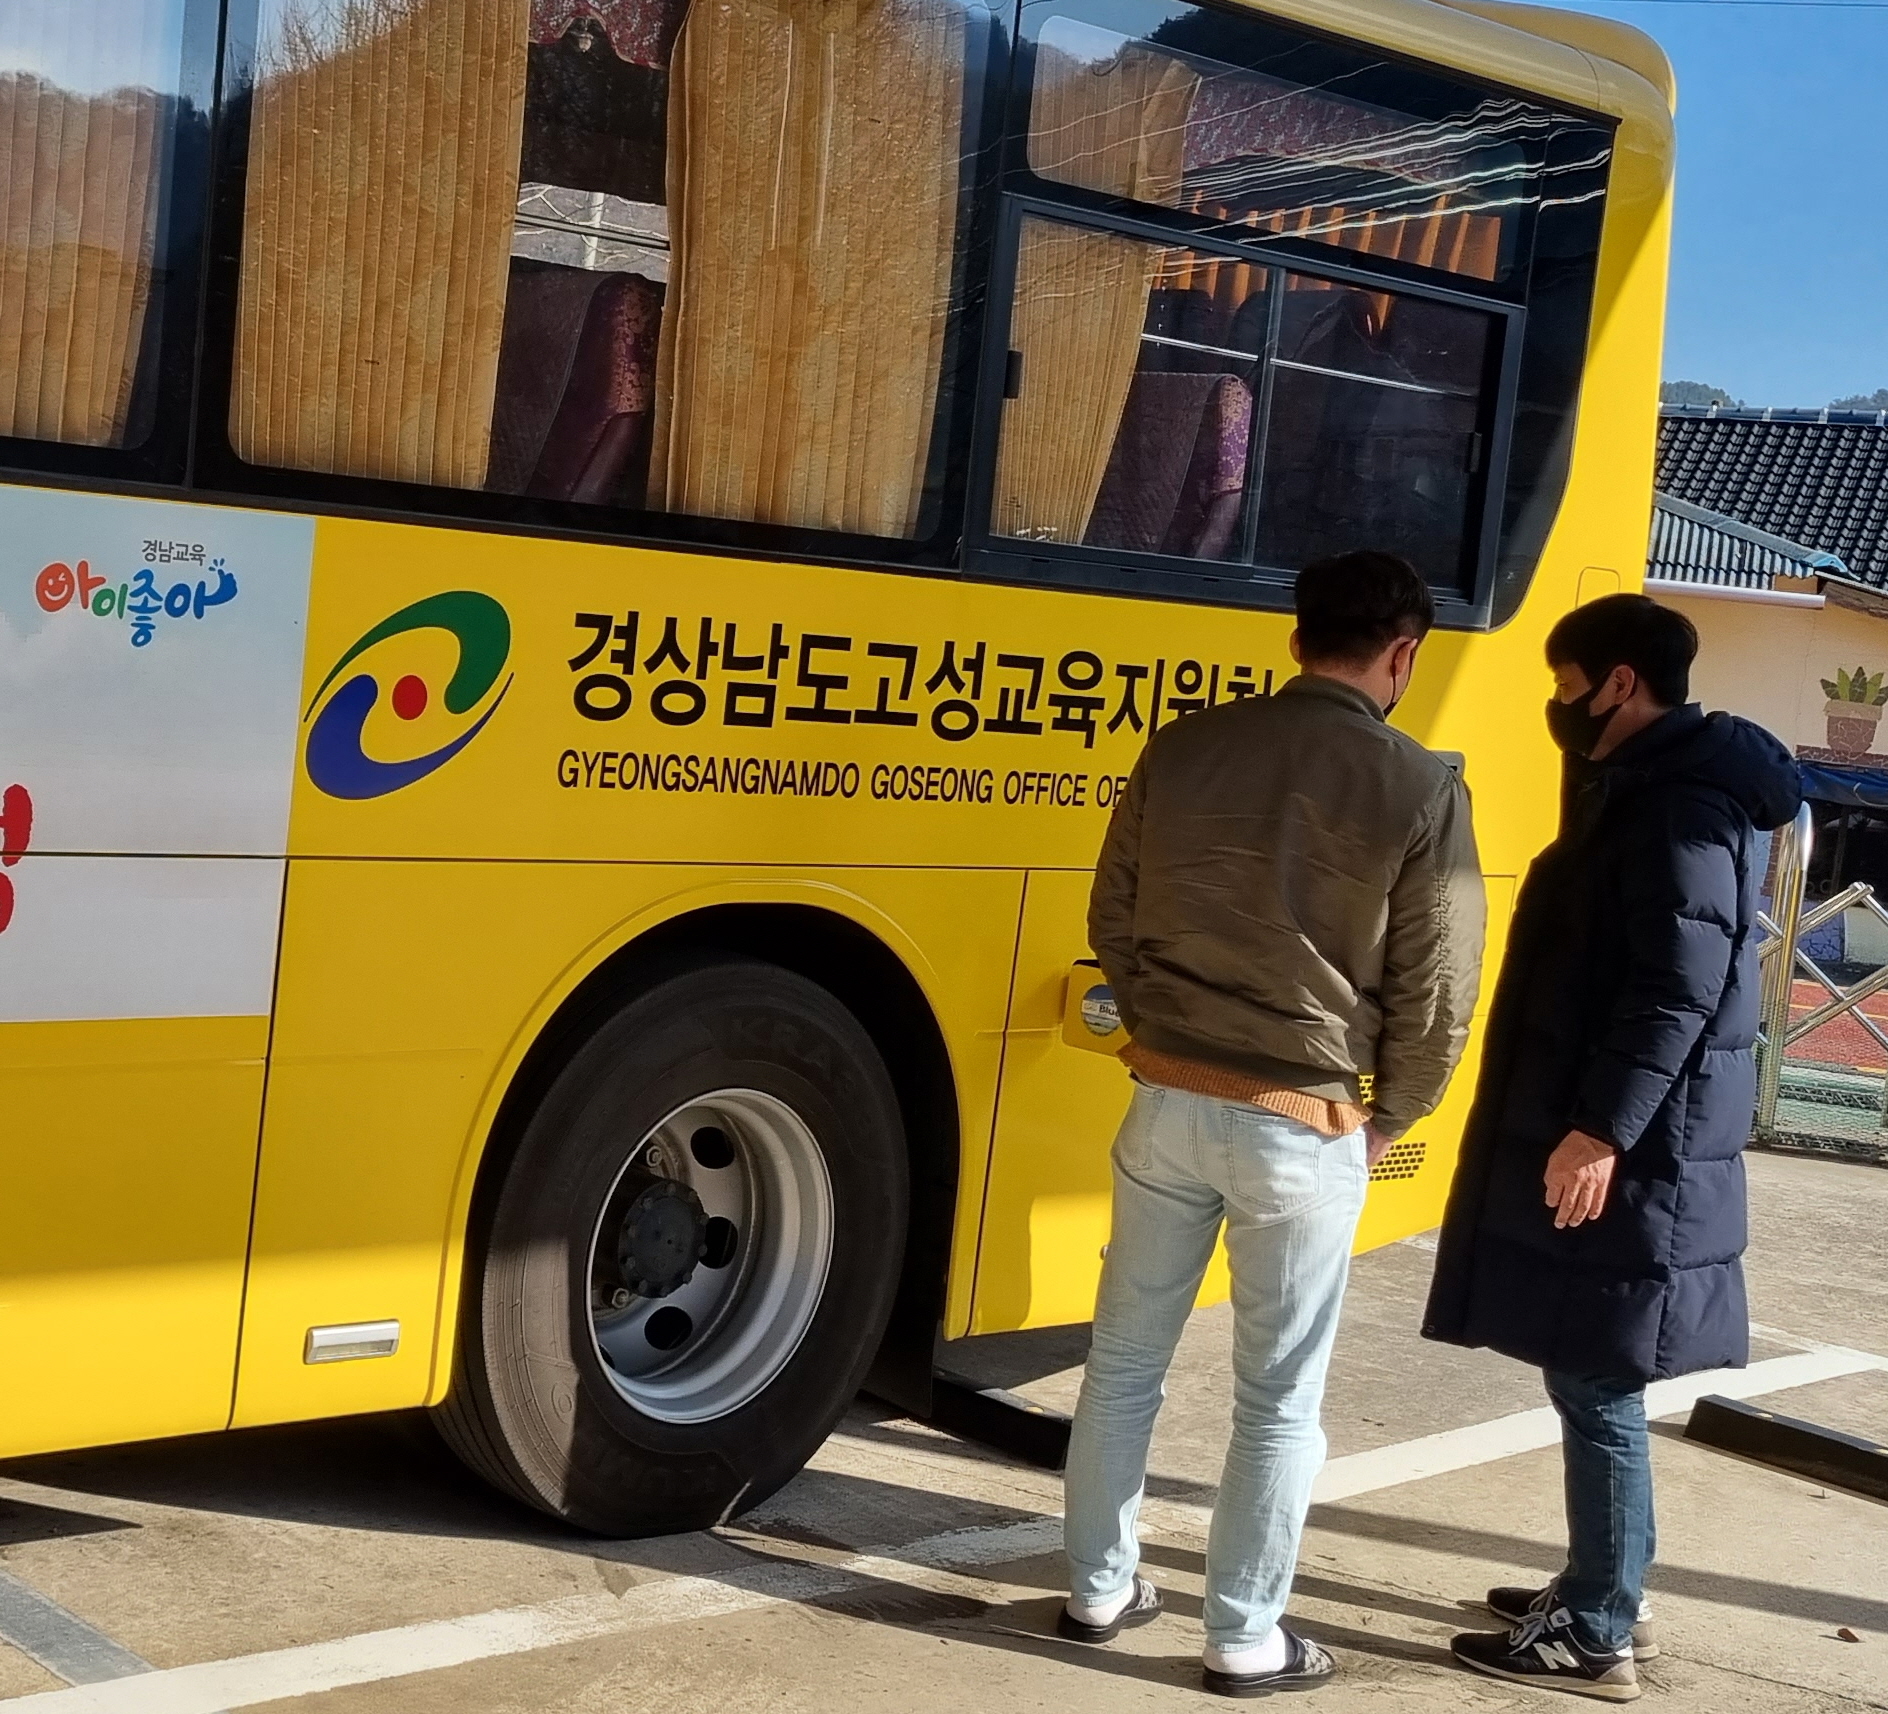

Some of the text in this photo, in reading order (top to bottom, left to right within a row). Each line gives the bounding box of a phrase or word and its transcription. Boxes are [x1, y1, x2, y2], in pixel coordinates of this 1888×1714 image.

[141, 539, 207, 567] 경남교육
[35, 559, 238, 647] 아이좋아
[557, 748, 1128, 808] GYEONGSANGNAMDO GOSEONG OFFICE OF
[1532, 1640, 1580, 1670] N
